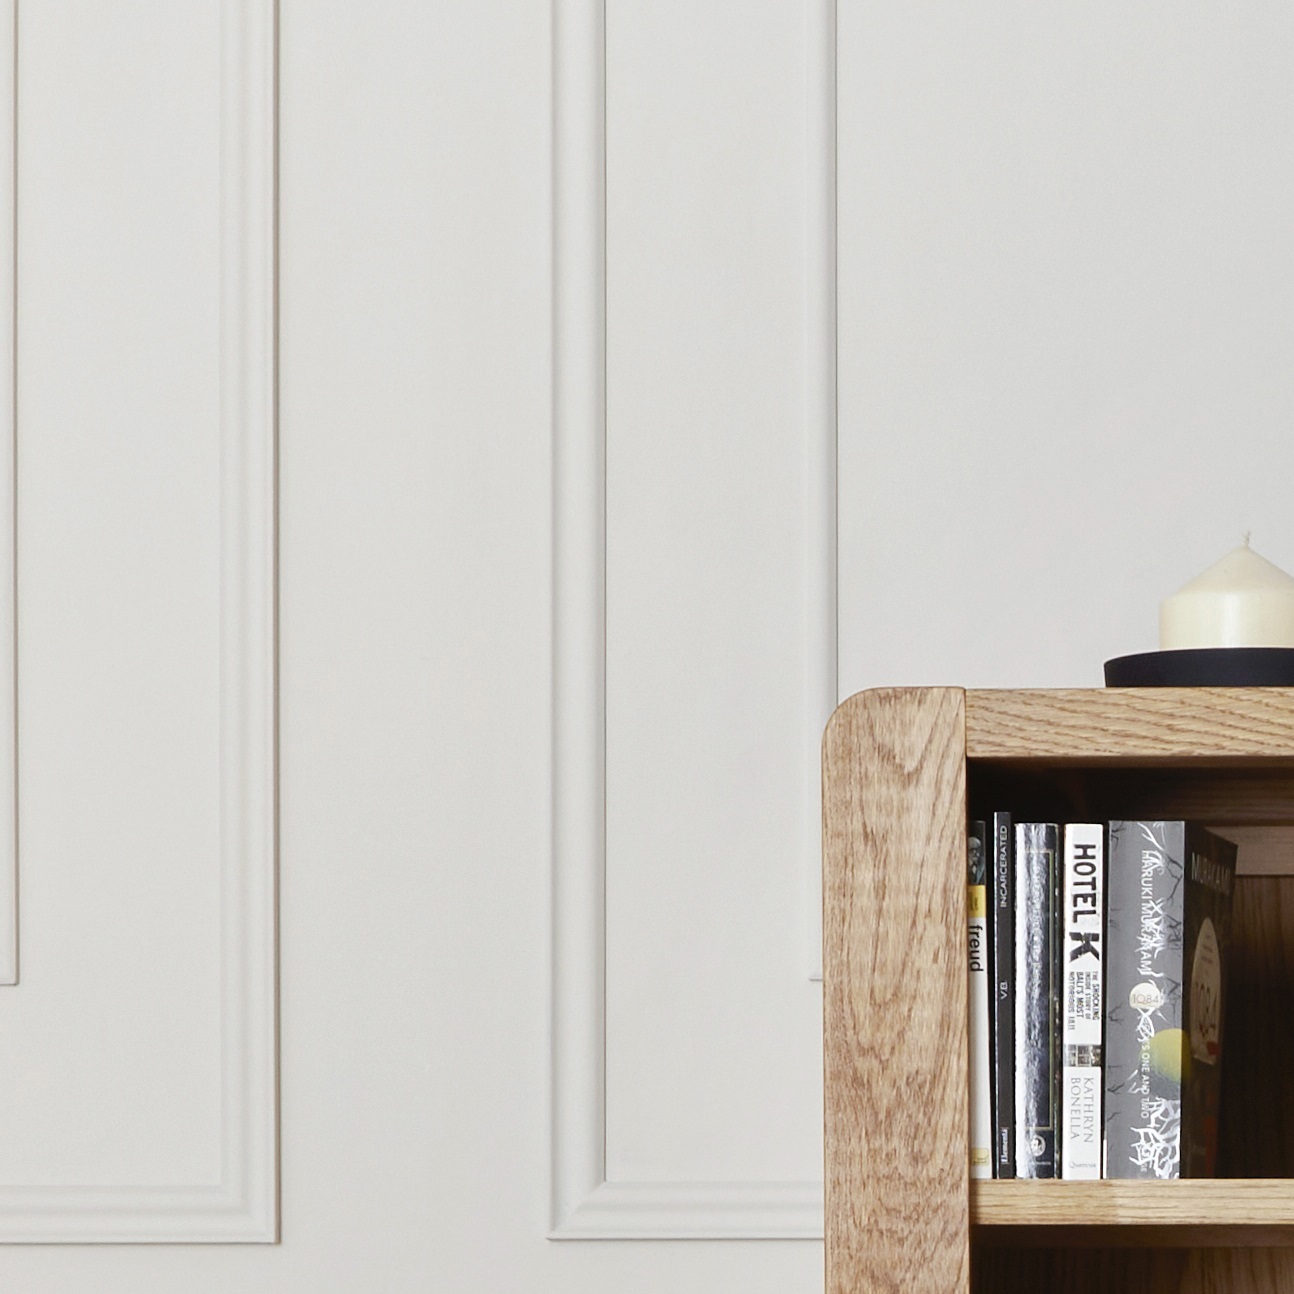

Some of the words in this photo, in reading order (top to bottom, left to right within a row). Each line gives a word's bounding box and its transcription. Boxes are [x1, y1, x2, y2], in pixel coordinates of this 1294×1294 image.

[999, 825, 1008, 907] INCARCERATED
[1072, 843, 1097, 924] HOTEL
[1141, 849, 1154, 899] HARUKI
[968, 925, 985, 972] freud
[1068, 932, 1100, 963] K
[1076, 997, 1084, 1019] MOST
[1092, 983, 1100, 1021] SHOCKING
[1132, 993, 1159, 1005] 1Q84
[1141, 1052, 1150, 1072] ONE
[1141, 1074, 1150, 1095] AND
[1070, 1077, 1081, 1140] BONELLA
[1083, 1077, 1094, 1143] KATHRYN
